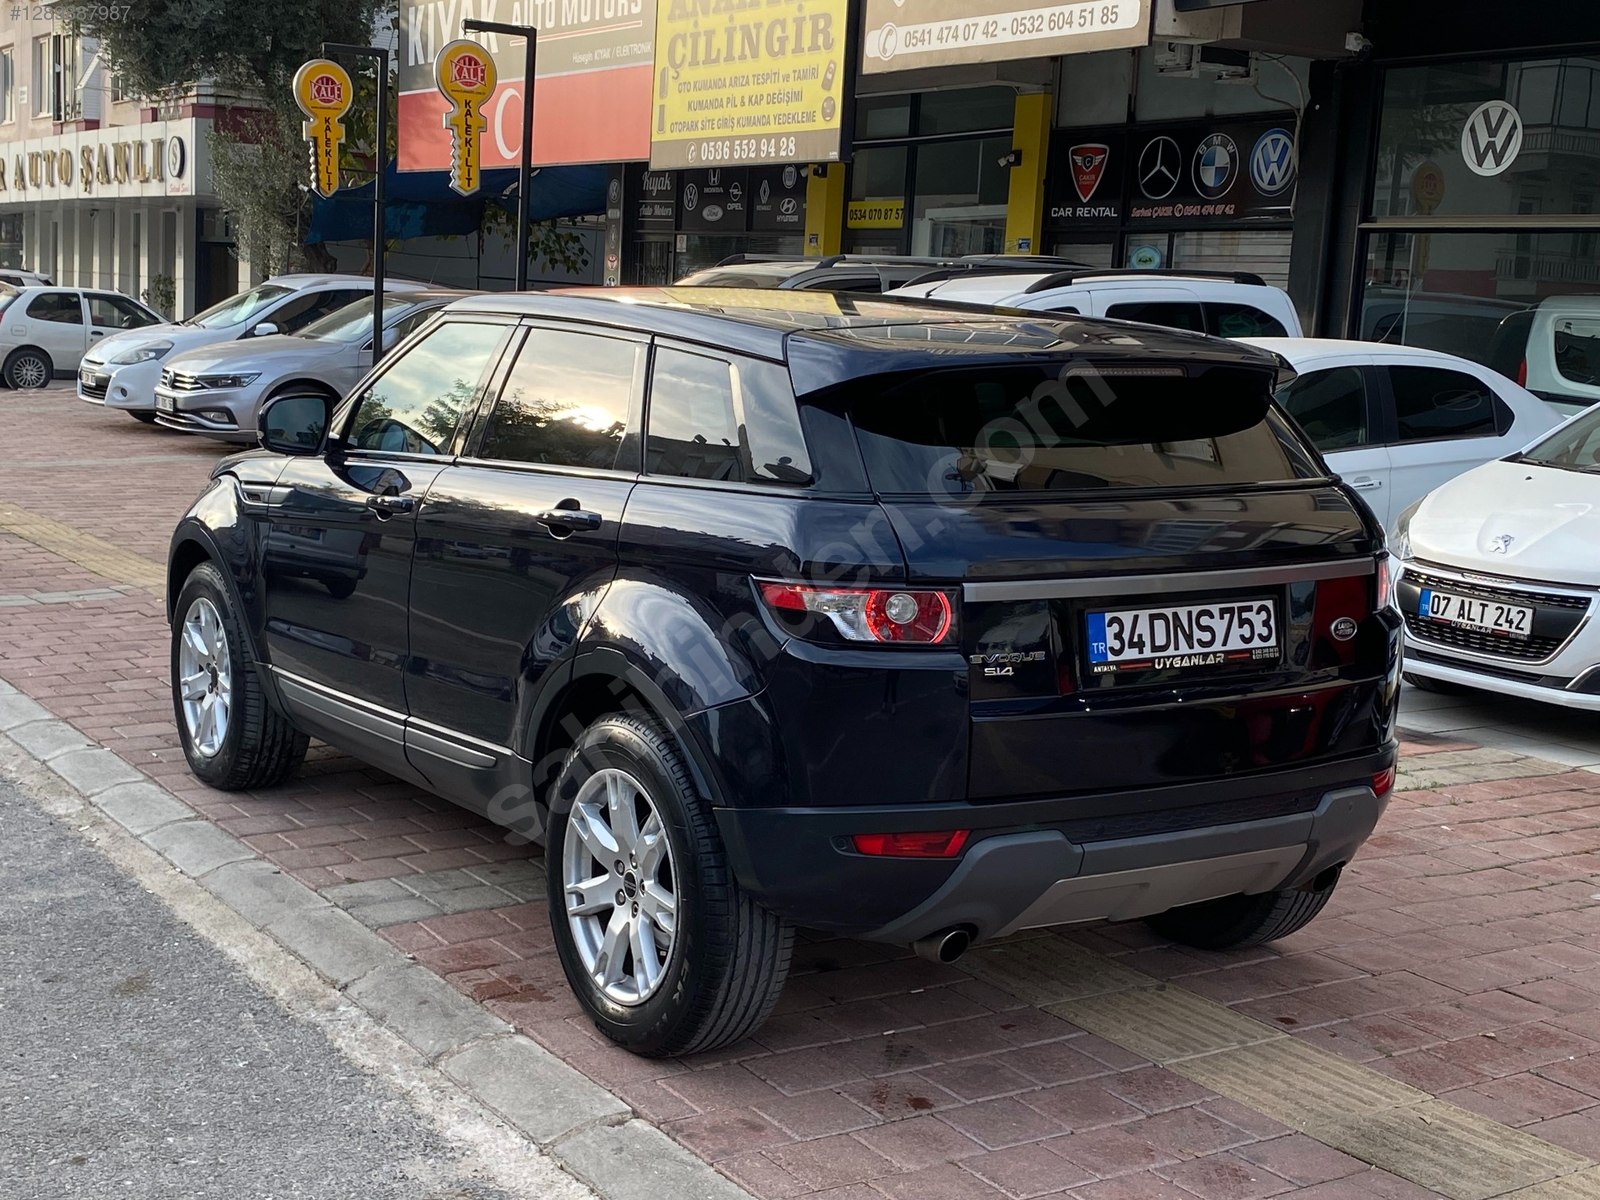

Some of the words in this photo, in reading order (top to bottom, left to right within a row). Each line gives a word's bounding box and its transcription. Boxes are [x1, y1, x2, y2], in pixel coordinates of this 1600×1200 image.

[904, 30, 933, 48] 0541
[937, 25, 960, 45] 474
[963, 23, 979, 42] 07
[982, 20, 998, 39] 42
[1011, 15, 1044, 35] 0532
[1049, 11, 1074, 31] 604
[1078, 8, 1095, 27] 51
[1100, 5, 1119, 25] 85
[667, 4, 834, 80] ÇİLİNGİR
[451, 66, 486, 85] KALE
[678, 81, 692, 94] OTO
[693, 78, 727, 92] KUMANDA
[728, 75, 750, 88] ARIZA
[752, 70, 780, 86] TESPİTİ
[782, 73, 790, 83] ve
[311, 82, 342, 101] KALE
[687, 97, 724, 112] KUMANDA
[725, 93, 738, 108] PİL
[740, 96, 746, 107] &
[748, 93, 764, 106] KAP
[670, 120, 699, 133] OTOPARK
[700, 117, 716, 131] SİTE
[736, 114, 771, 129] KUMANDA
[773, 110, 816, 125] YEDEKLEME
[701, 140, 730, 161] 0536
[733, 138, 756, 160] 552
[760, 137, 776, 158] 94
[779, 136, 796, 157] 28
[1198, 135, 1237, 155] BMW
[13, 148, 73, 191] AUTO
[79, 137, 165, 194] ŞANLI
[849, 209, 867, 221] 0534
[868, 208, 882, 220] 070
[884, 208, 893, 220] 87
[895, 208, 904, 220] 57
[1051, 207, 1073, 217] CAR
[1076, 206, 1118, 217] RENTAL
[1430, 594, 1451, 616] 07
[1457, 599, 1489, 624] ALT
[1493, 605, 1526, 631] 242
[969, 651, 1046, 664] EVOQUE
[1092, 642, 1106, 655] TR
[1093, 665, 1117, 673] ANTALYA
[1154, 652, 1225, 670] UYGANLAR
